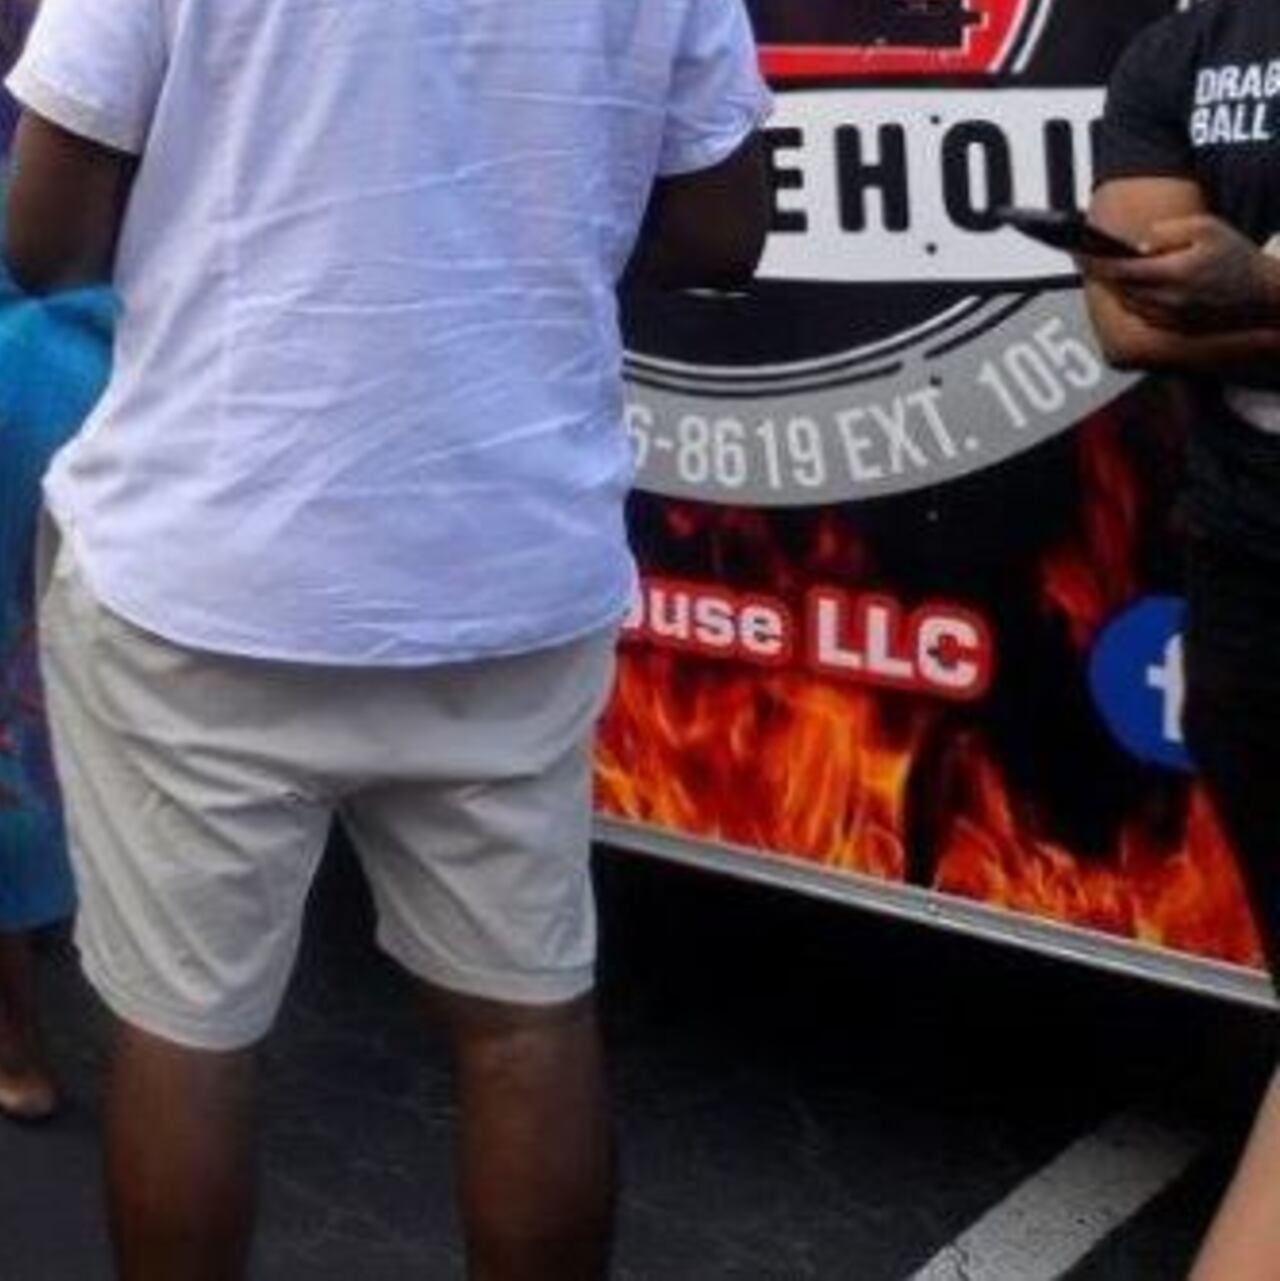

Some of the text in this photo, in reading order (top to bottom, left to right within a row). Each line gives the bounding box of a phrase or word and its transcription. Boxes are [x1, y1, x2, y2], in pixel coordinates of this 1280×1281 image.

[1190, 103, 1270, 148] BALL
[623, 316, 1103, 489] 6-8619 EXT. 105
[622, 588, 978, 690] use LLC
